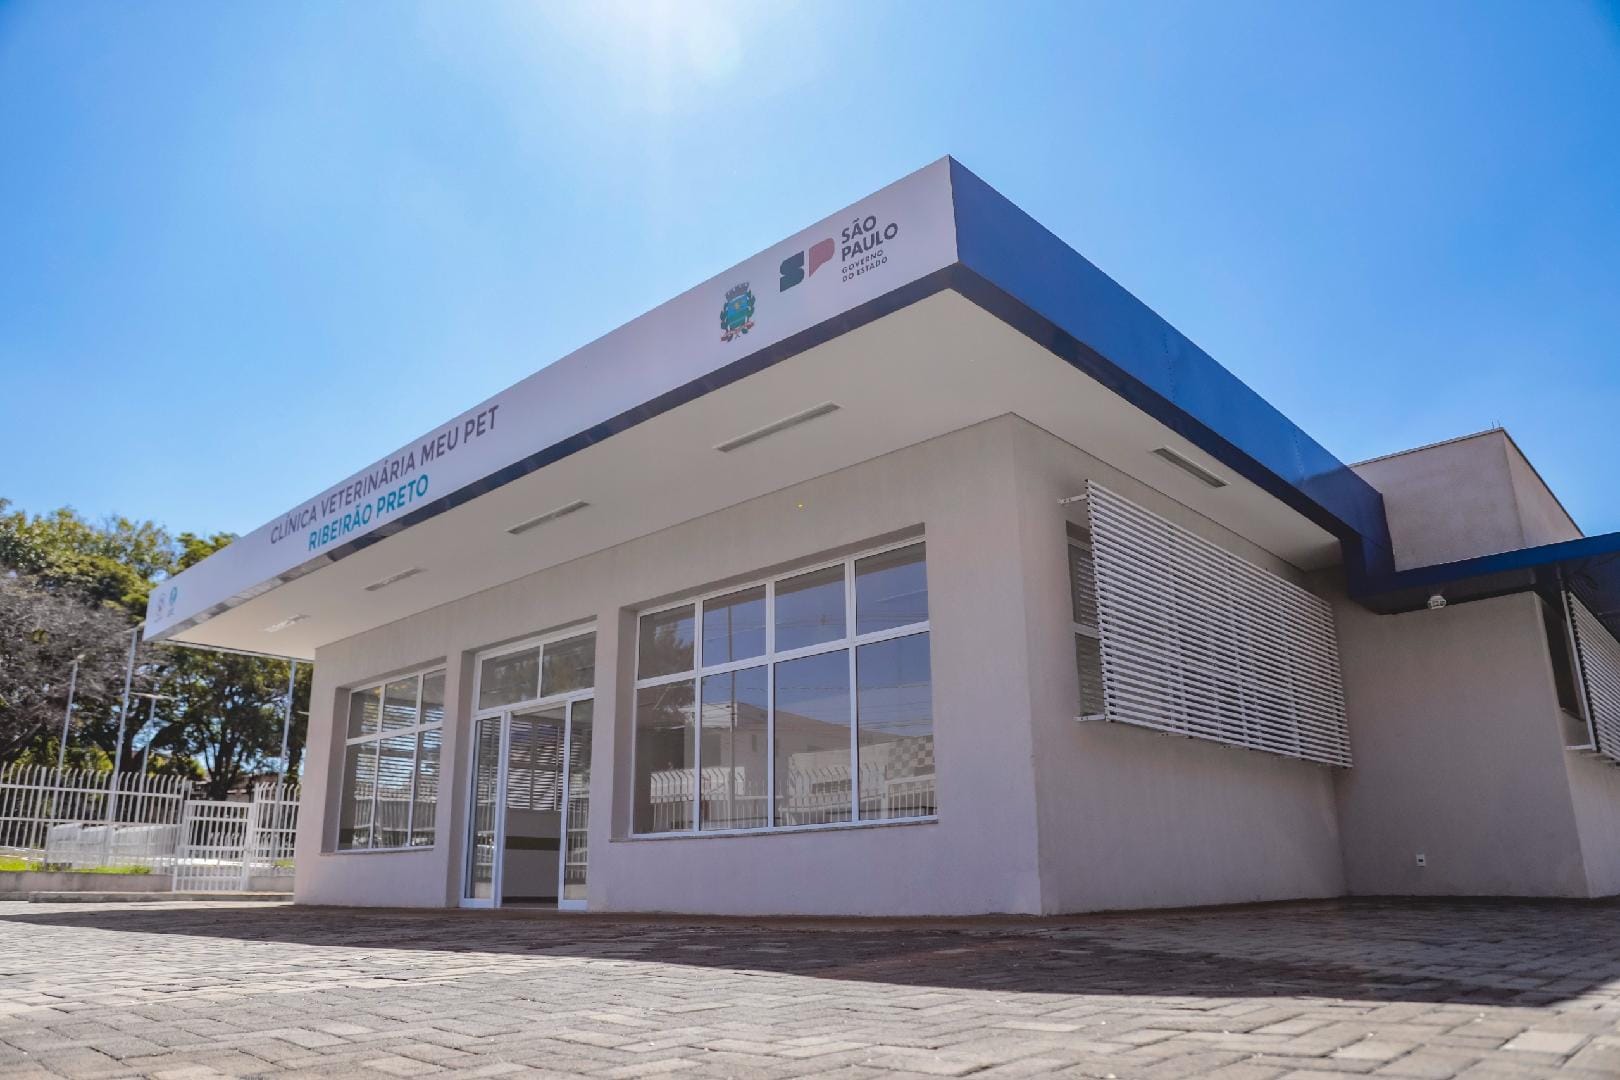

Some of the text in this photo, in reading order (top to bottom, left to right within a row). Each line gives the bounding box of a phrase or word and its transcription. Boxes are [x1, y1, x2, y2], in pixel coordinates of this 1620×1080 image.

[841, 214, 877, 244] SÃO
[841, 222, 899, 262] PAULO
[779, 237, 836, 293] SP
[841, 249, 884, 275] GOVERNO
[842, 256, 888, 283] DO ESTADO
[270, 404, 500, 544] CLÍNICA VETERINÁRIA MEU PET
[308, 474, 429, 551] RIBEIRÃO PRETO
